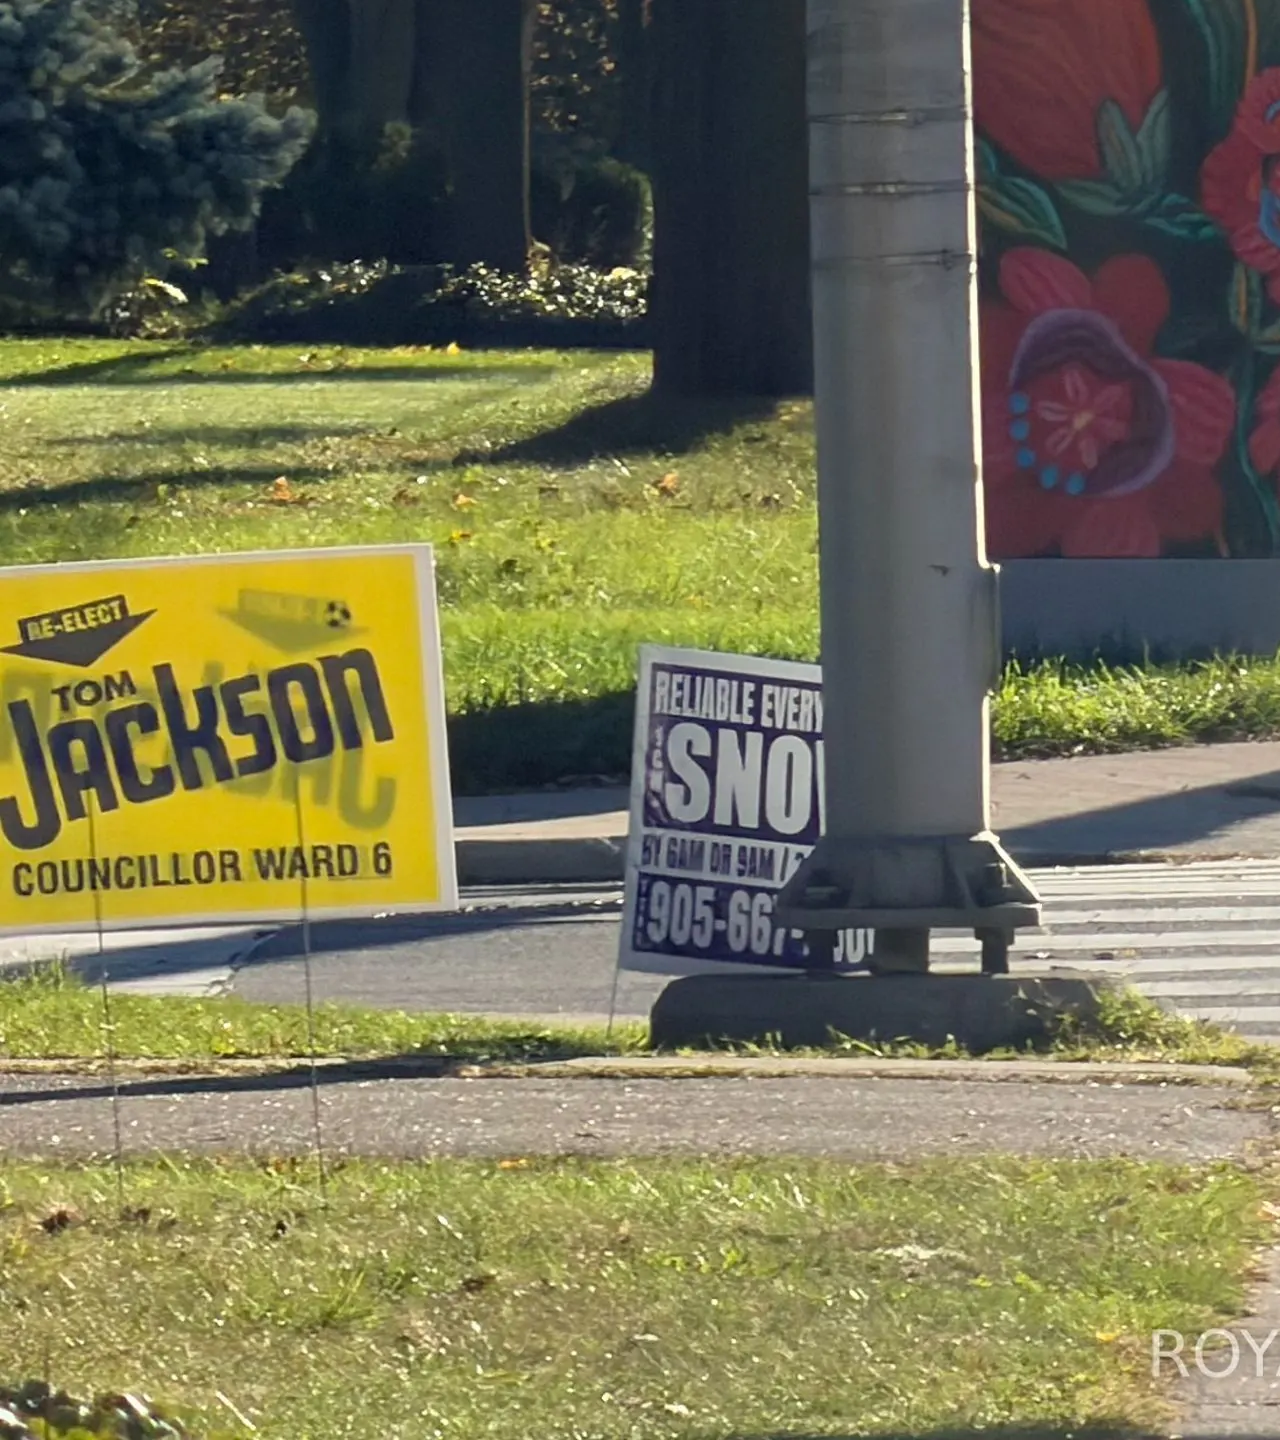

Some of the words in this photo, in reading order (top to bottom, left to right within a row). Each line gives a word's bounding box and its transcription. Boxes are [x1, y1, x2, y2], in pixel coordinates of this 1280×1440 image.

[27, 600, 123, 641] RE-ELECT
[51, 669, 137, 713] TOM
[655, 671, 756, 725] RELIABLE
[664, 722, 826, 838] SNO
[13, 849, 242, 897] COUNCILLOR
[254, 843, 359, 880] WARD
[373, 842, 392, 876] 6
